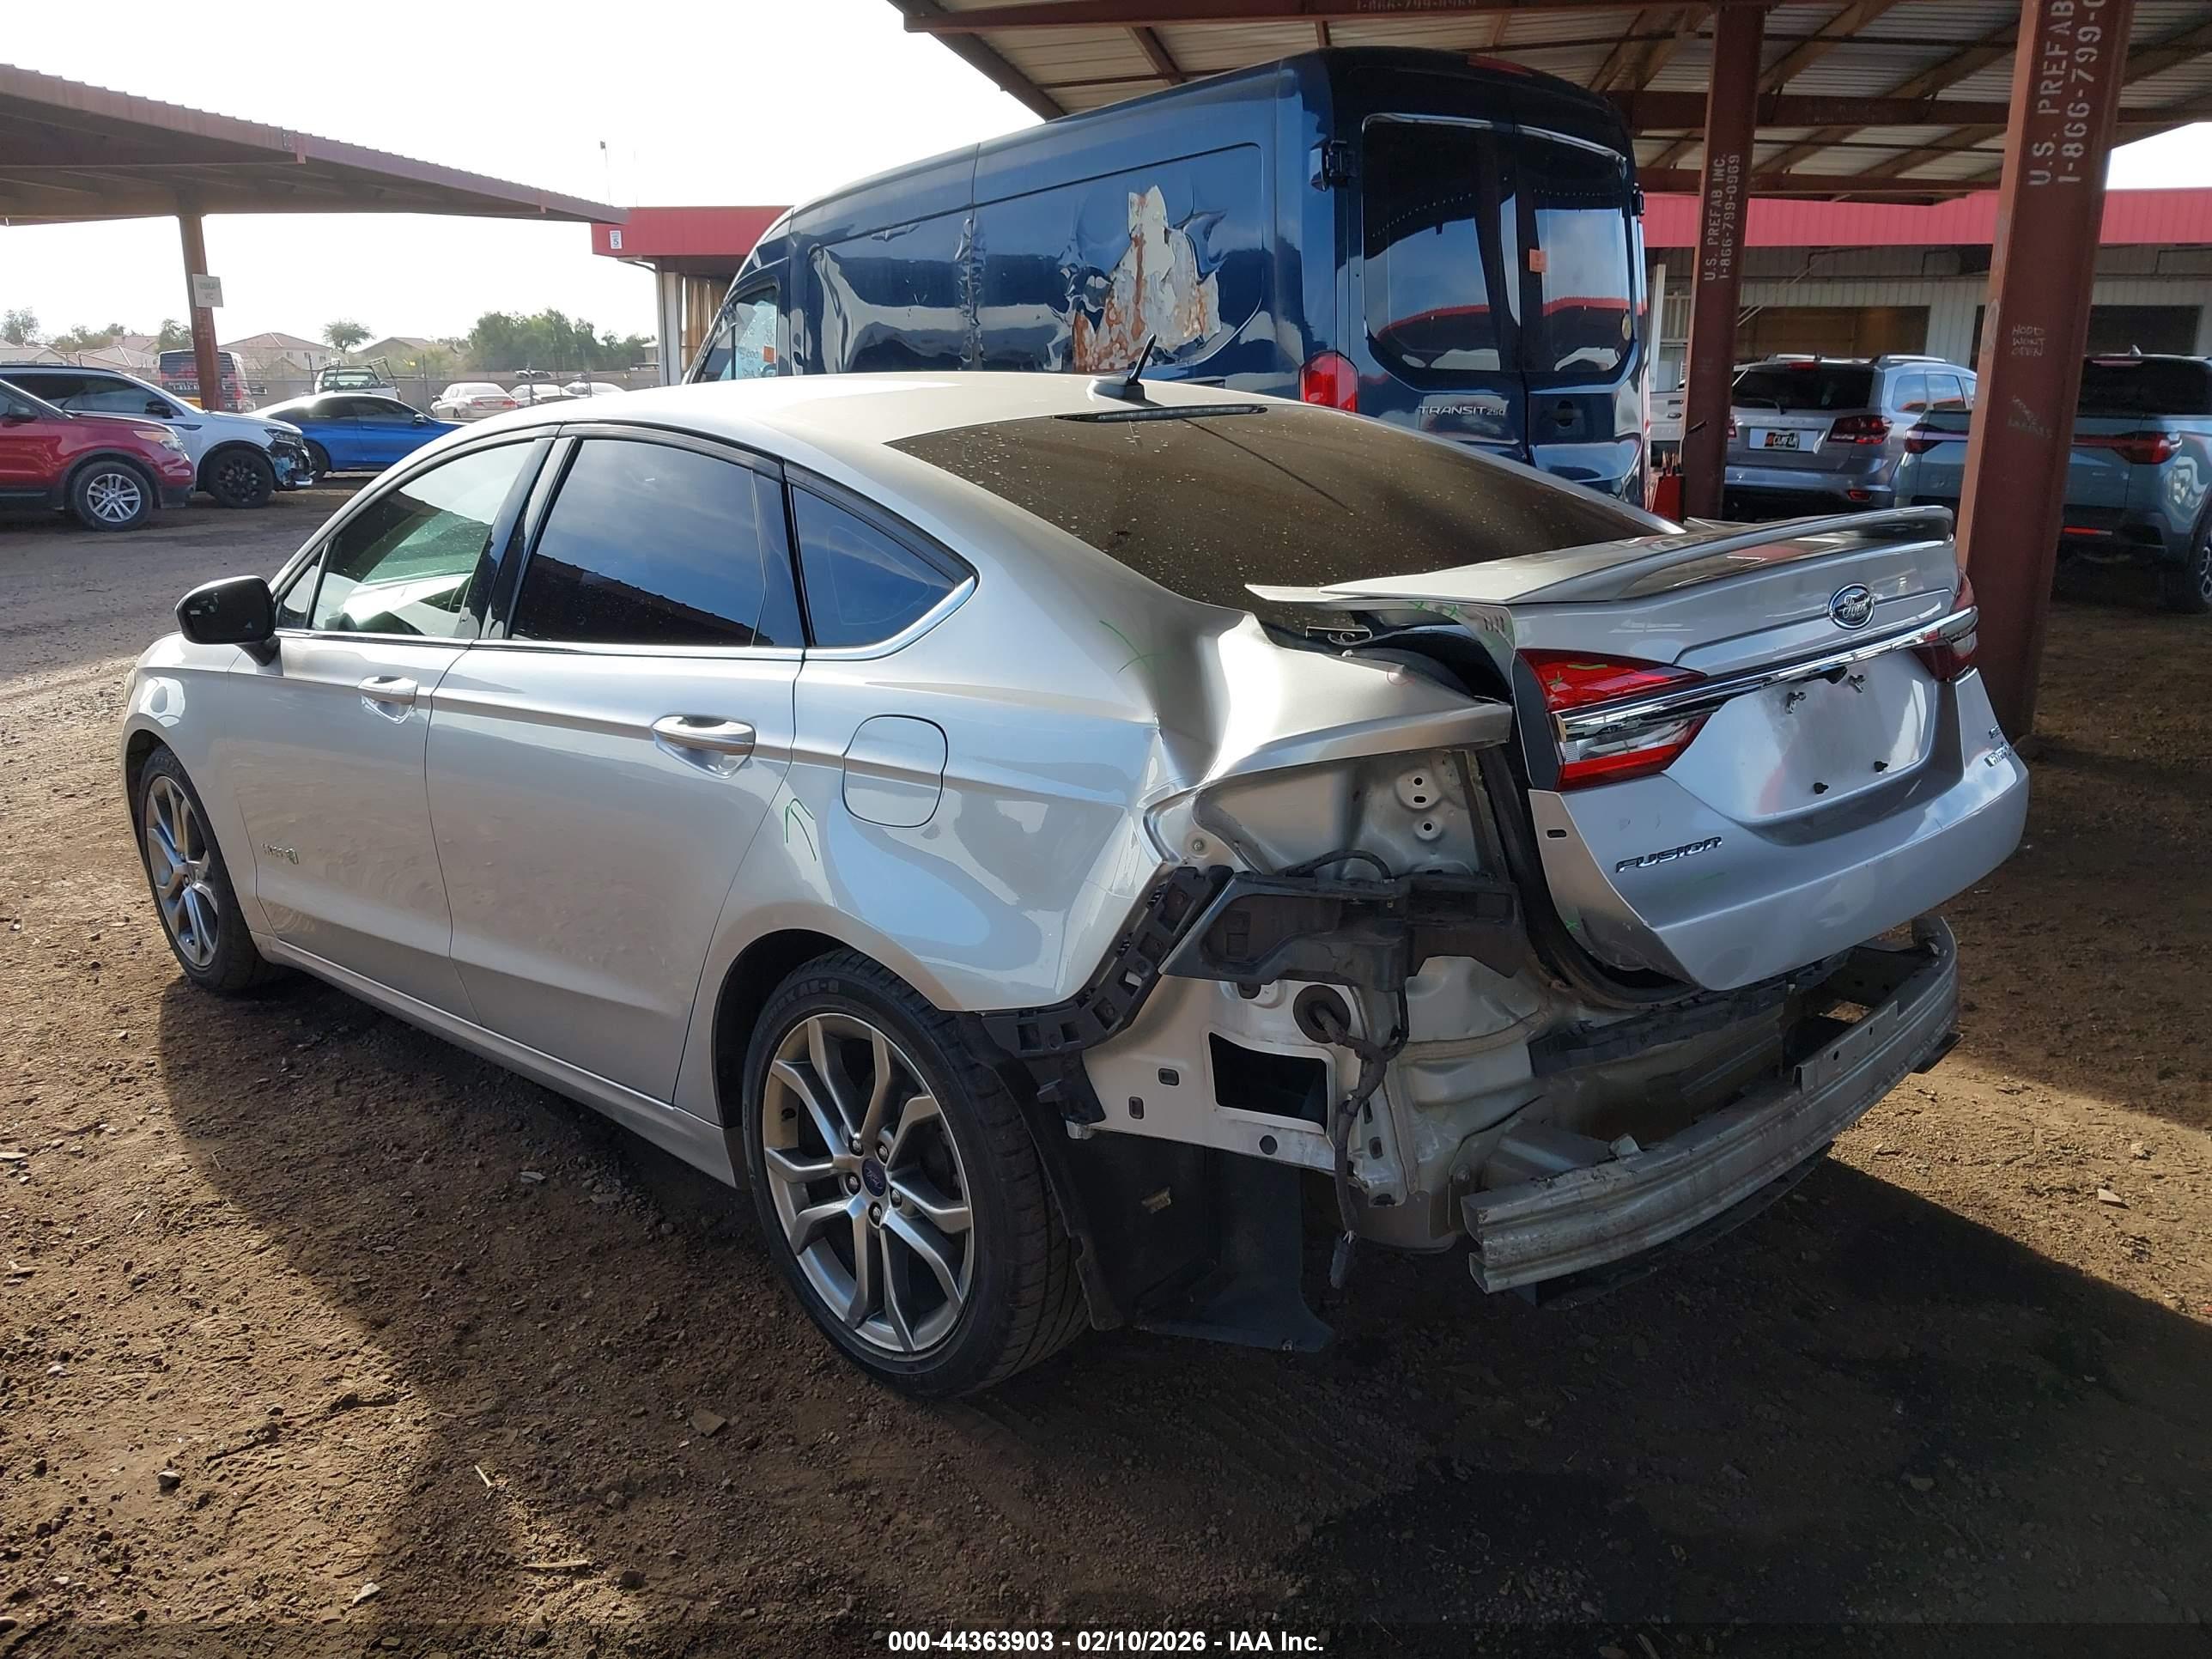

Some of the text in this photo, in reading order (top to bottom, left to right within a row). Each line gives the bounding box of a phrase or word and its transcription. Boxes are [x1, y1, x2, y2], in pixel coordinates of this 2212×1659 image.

[2028, 0, 2075, 185] U.S. PREFAB
[1704, 153, 1727, 281] U.S. PREFAB INC.
[1718, 155, 1741, 280] 1-866-799-0969
[1418, 405, 1486, 416] TRANSIT
[1615, 836, 1723, 874] FUSION
